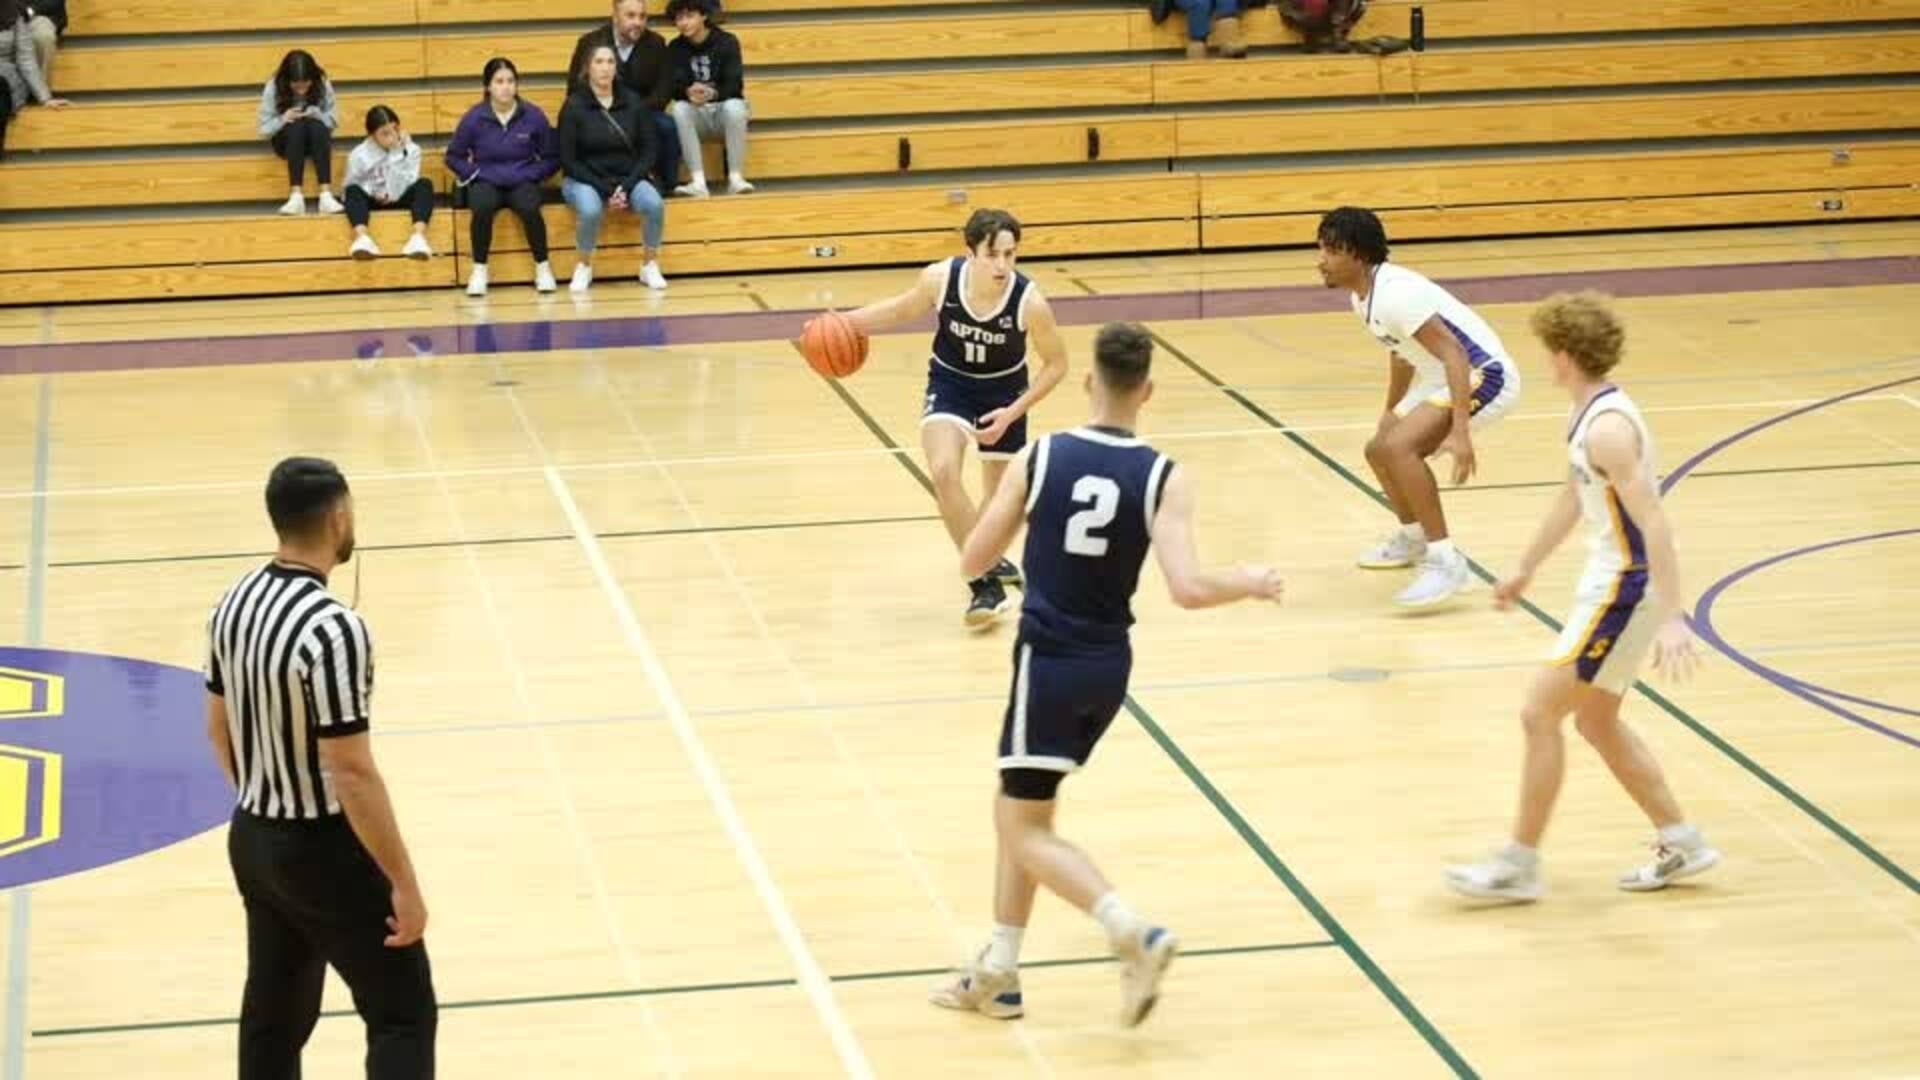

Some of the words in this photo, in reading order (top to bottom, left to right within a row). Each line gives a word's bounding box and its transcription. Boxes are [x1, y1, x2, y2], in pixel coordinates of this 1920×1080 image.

[949, 319, 1006, 345] APTOS
[964, 341, 986, 363] 11
[1064, 474, 1120, 556] 2
